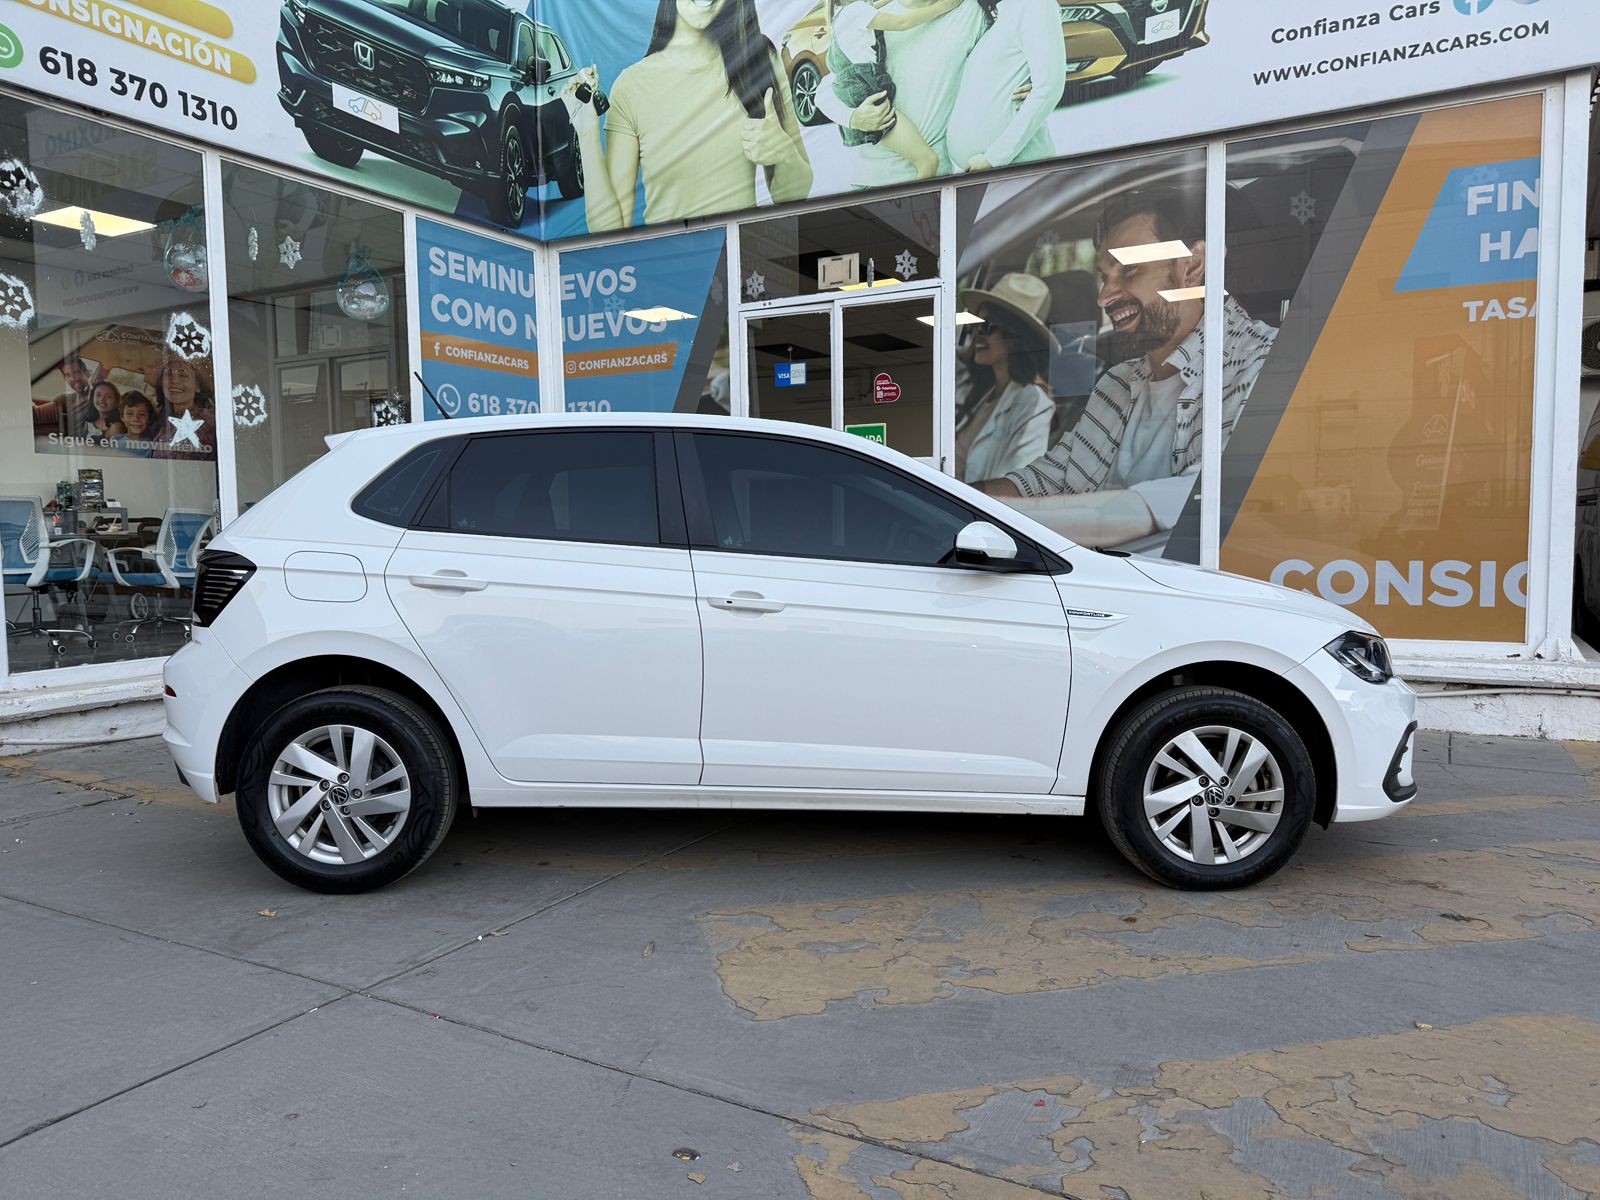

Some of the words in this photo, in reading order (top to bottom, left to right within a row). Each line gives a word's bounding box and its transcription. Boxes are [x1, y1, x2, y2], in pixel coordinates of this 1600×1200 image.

[1270, 10, 1381, 44] Confianza
[1388, 0, 1441, 22] Cars
[1252, 20, 1550, 86] WWW.CONFIANZACARS.COM
[39, 46, 98, 87] 618
[109, 67, 168, 109] 370
[177, 90, 238, 131] 1310
[430, 293, 517, 336] COMO
[445, 345, 529, 370] CONFIANZACARS
[578, 353, 668, 371] CONFIANZACARS
[777, 372, 791, 380] VISA
[467, 392, 501, 416] 618
[506, 397, 540, 415] 370
[567, 399, 612, 413] 1310
[48, 432, 95, 449] Sigue
[99, 439, 119, 448] en
